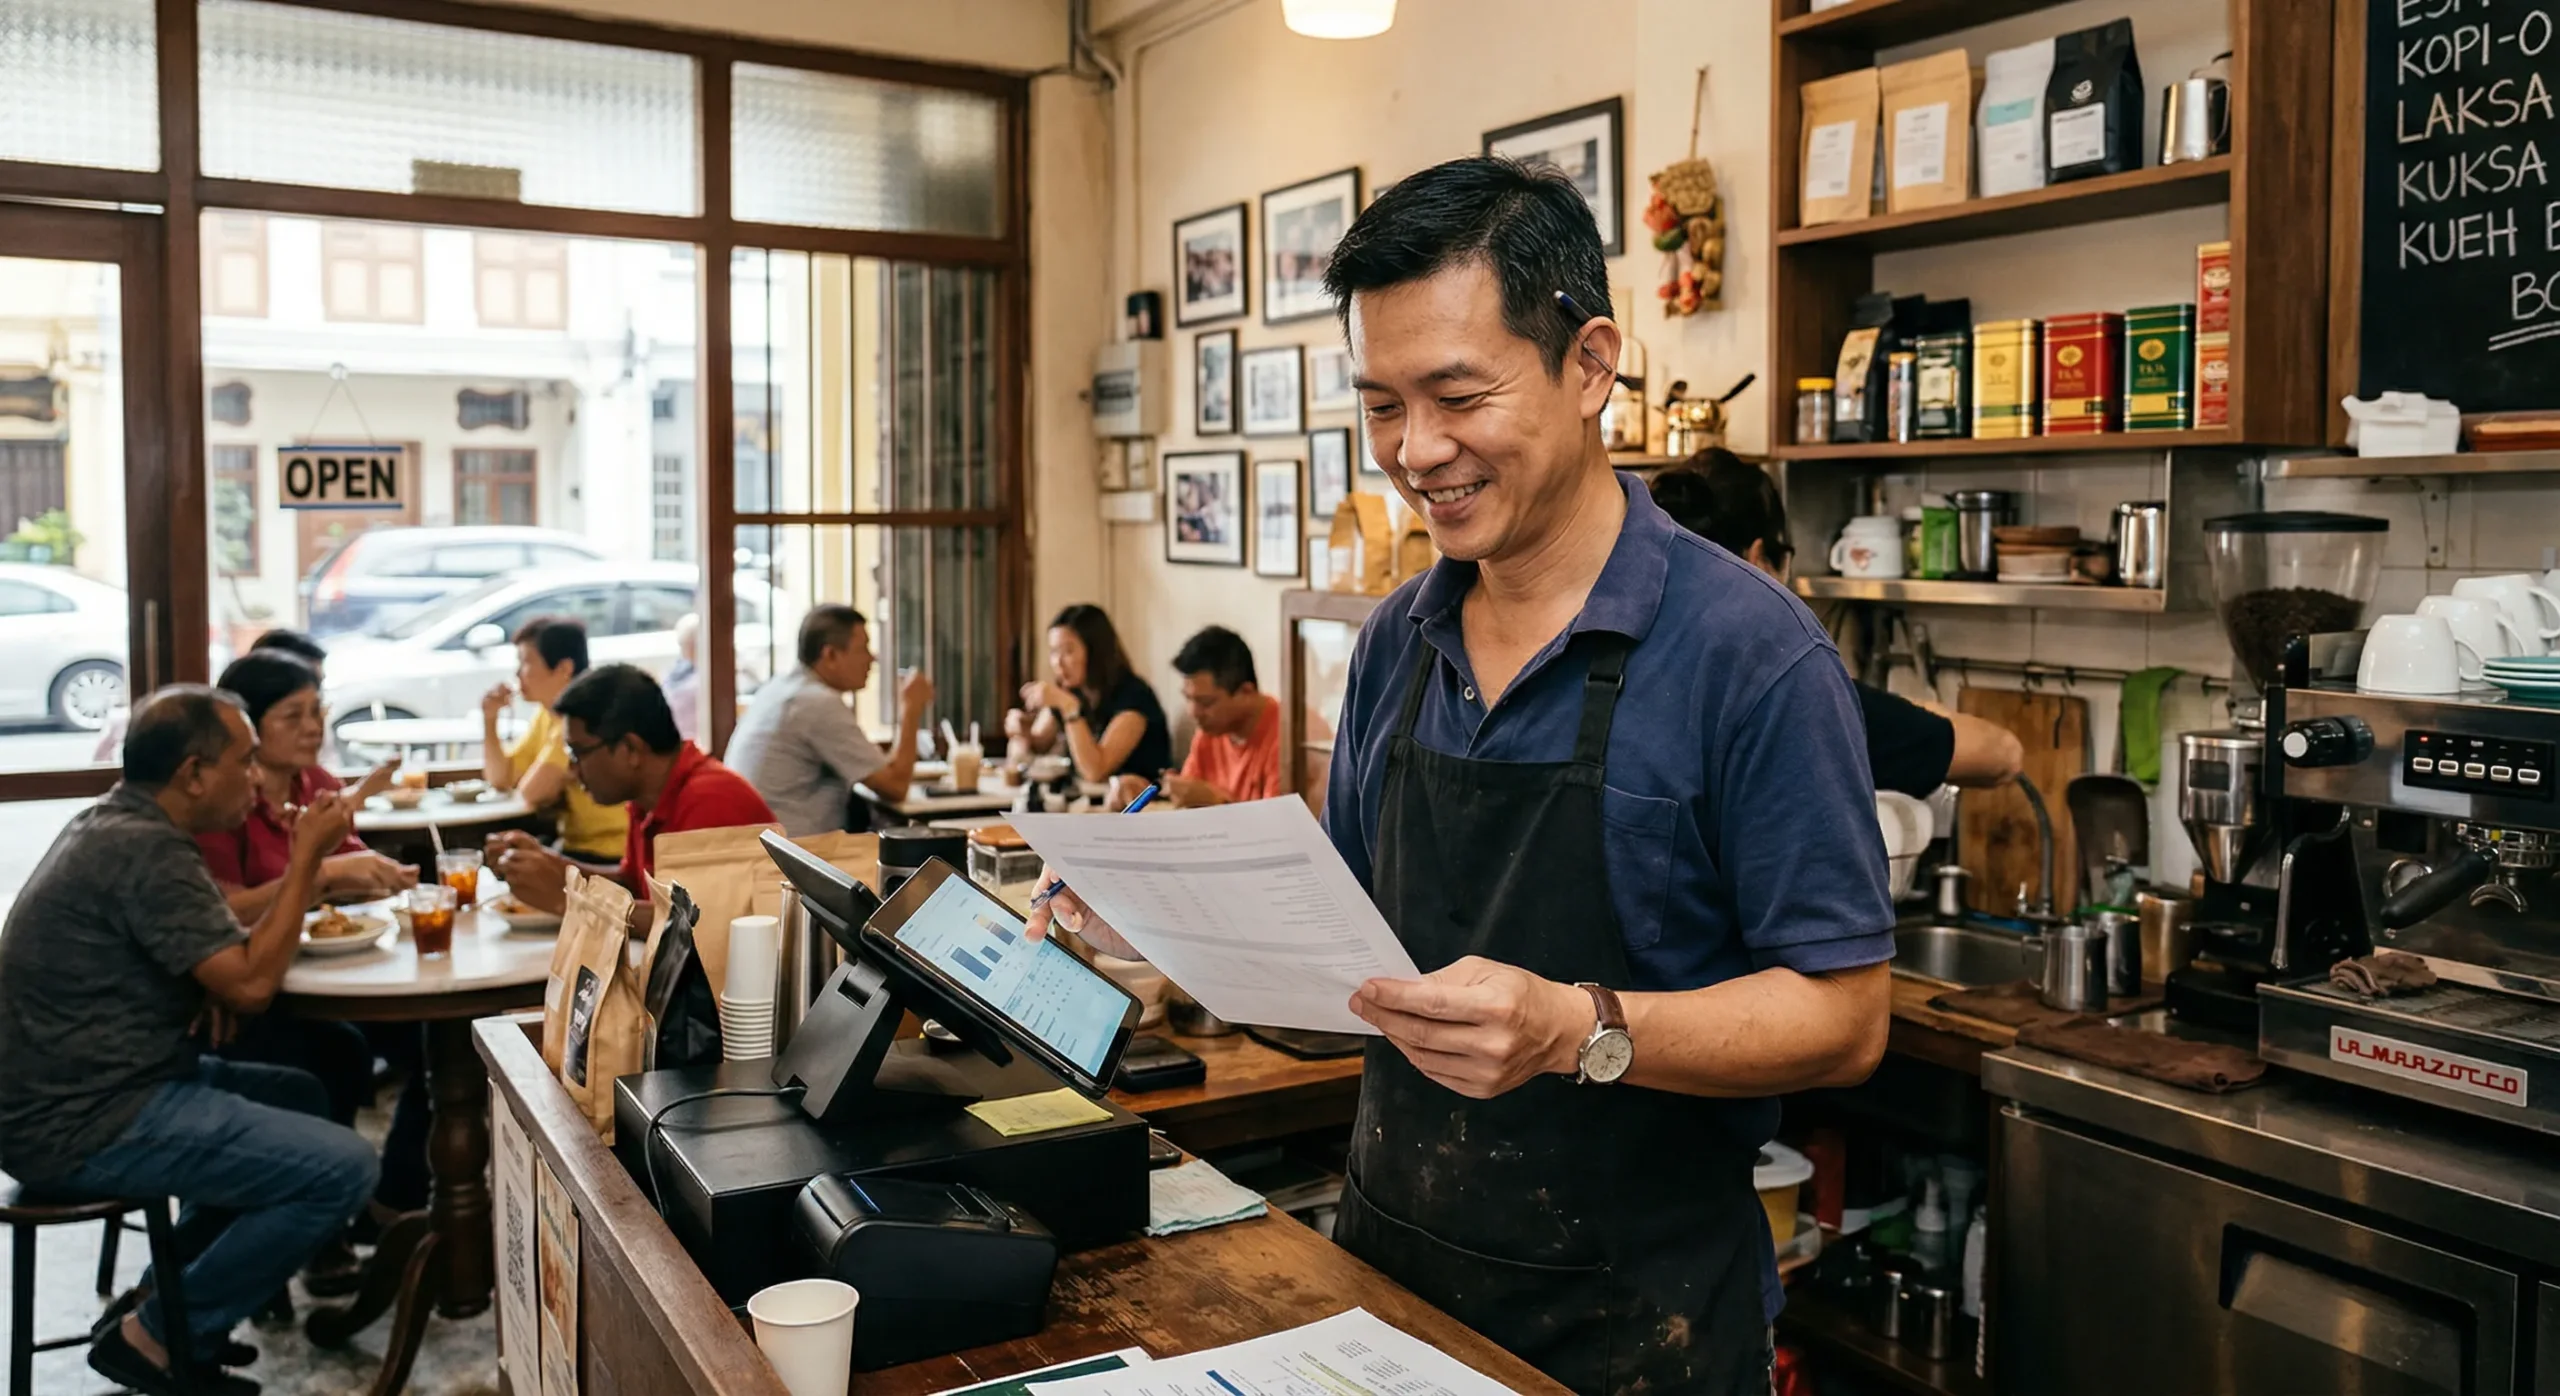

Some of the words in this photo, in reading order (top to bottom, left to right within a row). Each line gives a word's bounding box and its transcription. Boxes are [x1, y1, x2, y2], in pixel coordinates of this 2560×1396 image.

[2398, 10, 2552, 85] KOPI-O
[2397, 72, 2554, 144] LAKSA
[2398, 140, 2548, 207] KUKSA
[2400, 207, 2518, 269] KUEH
[285, 457, 396, 499] OPEN
